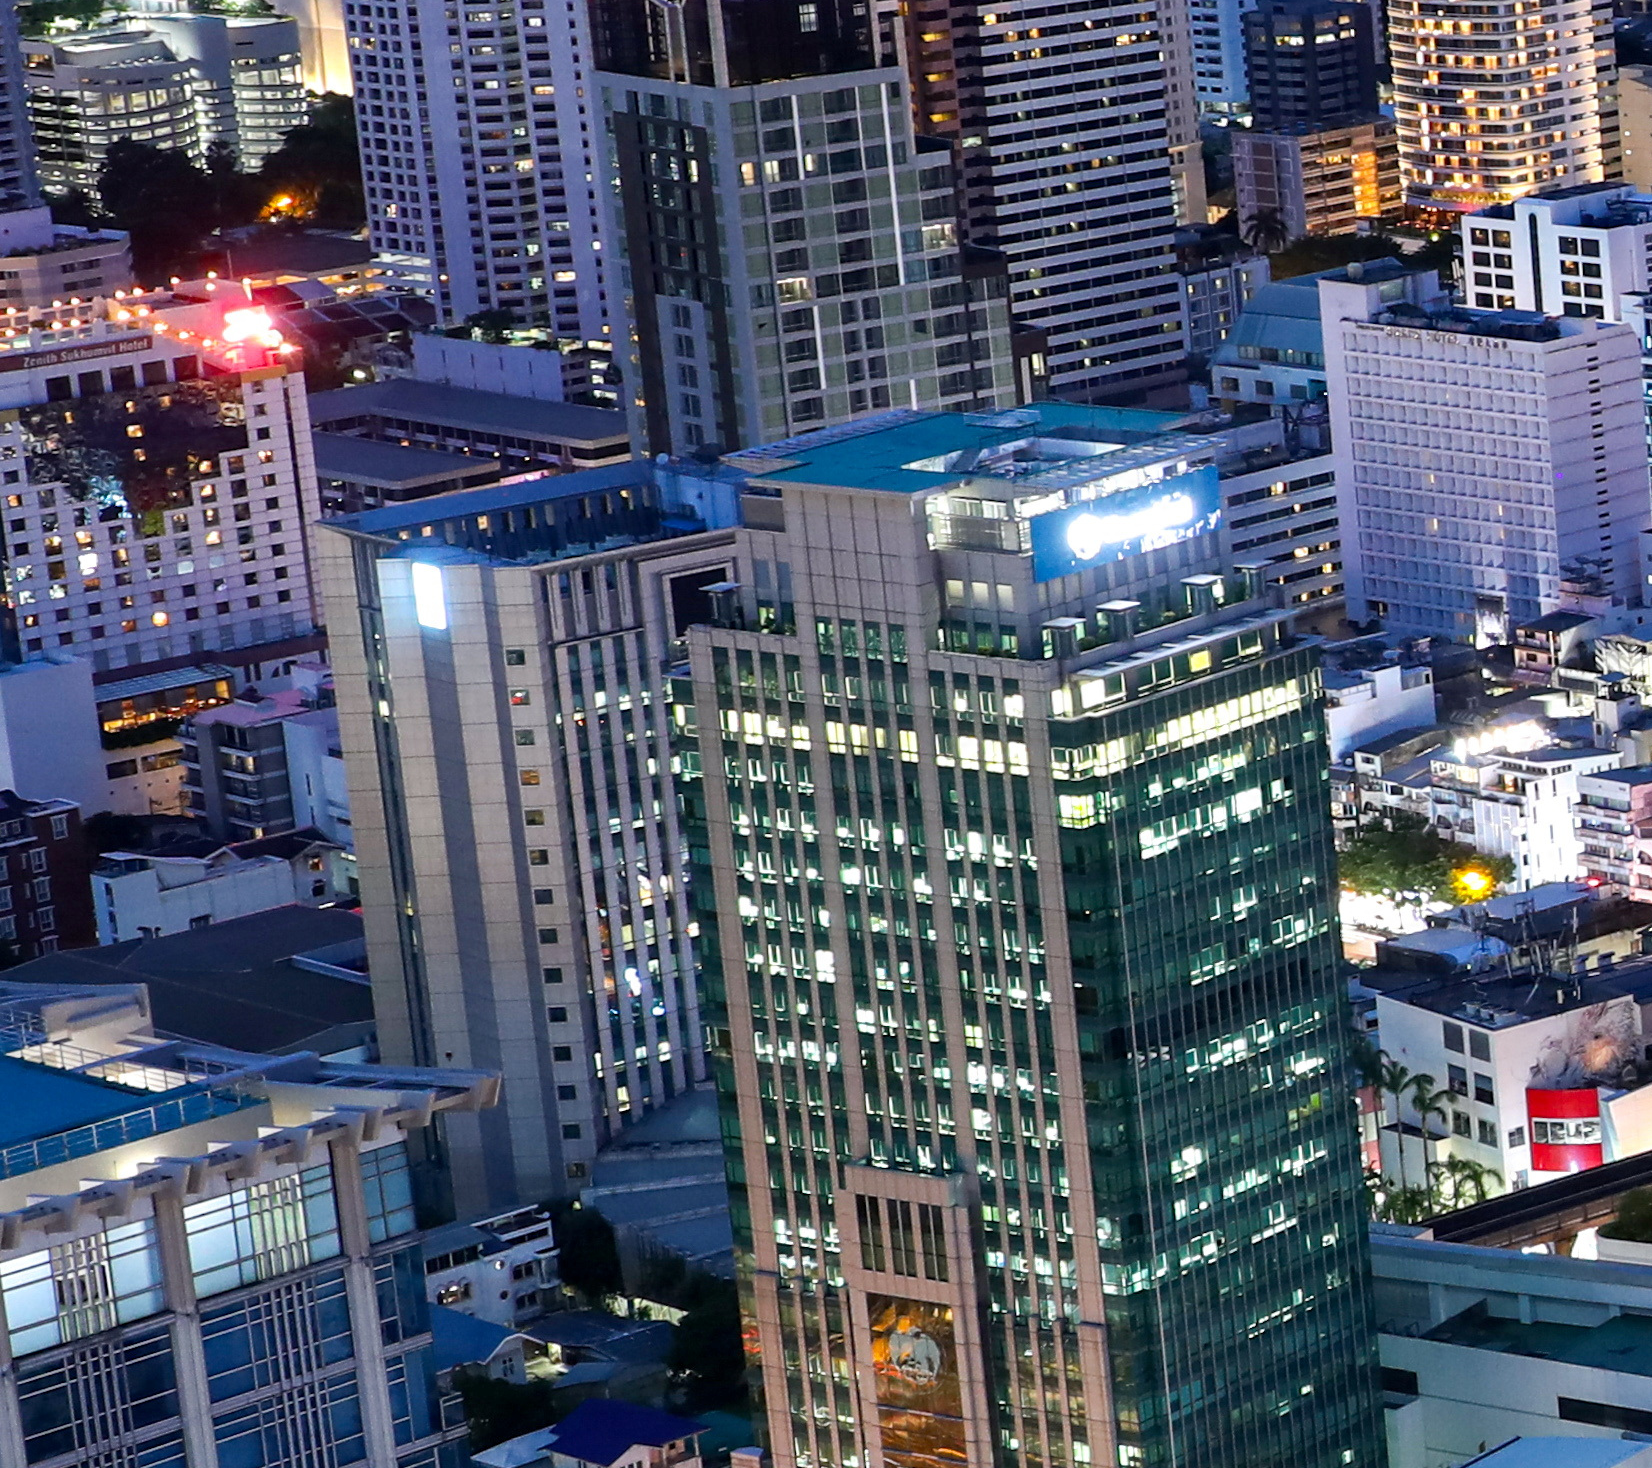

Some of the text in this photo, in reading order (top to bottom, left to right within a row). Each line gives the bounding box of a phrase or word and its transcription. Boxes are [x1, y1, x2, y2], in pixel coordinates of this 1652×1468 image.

[22, 337, 149, 370] Zenith Sukhumvit Hotel
